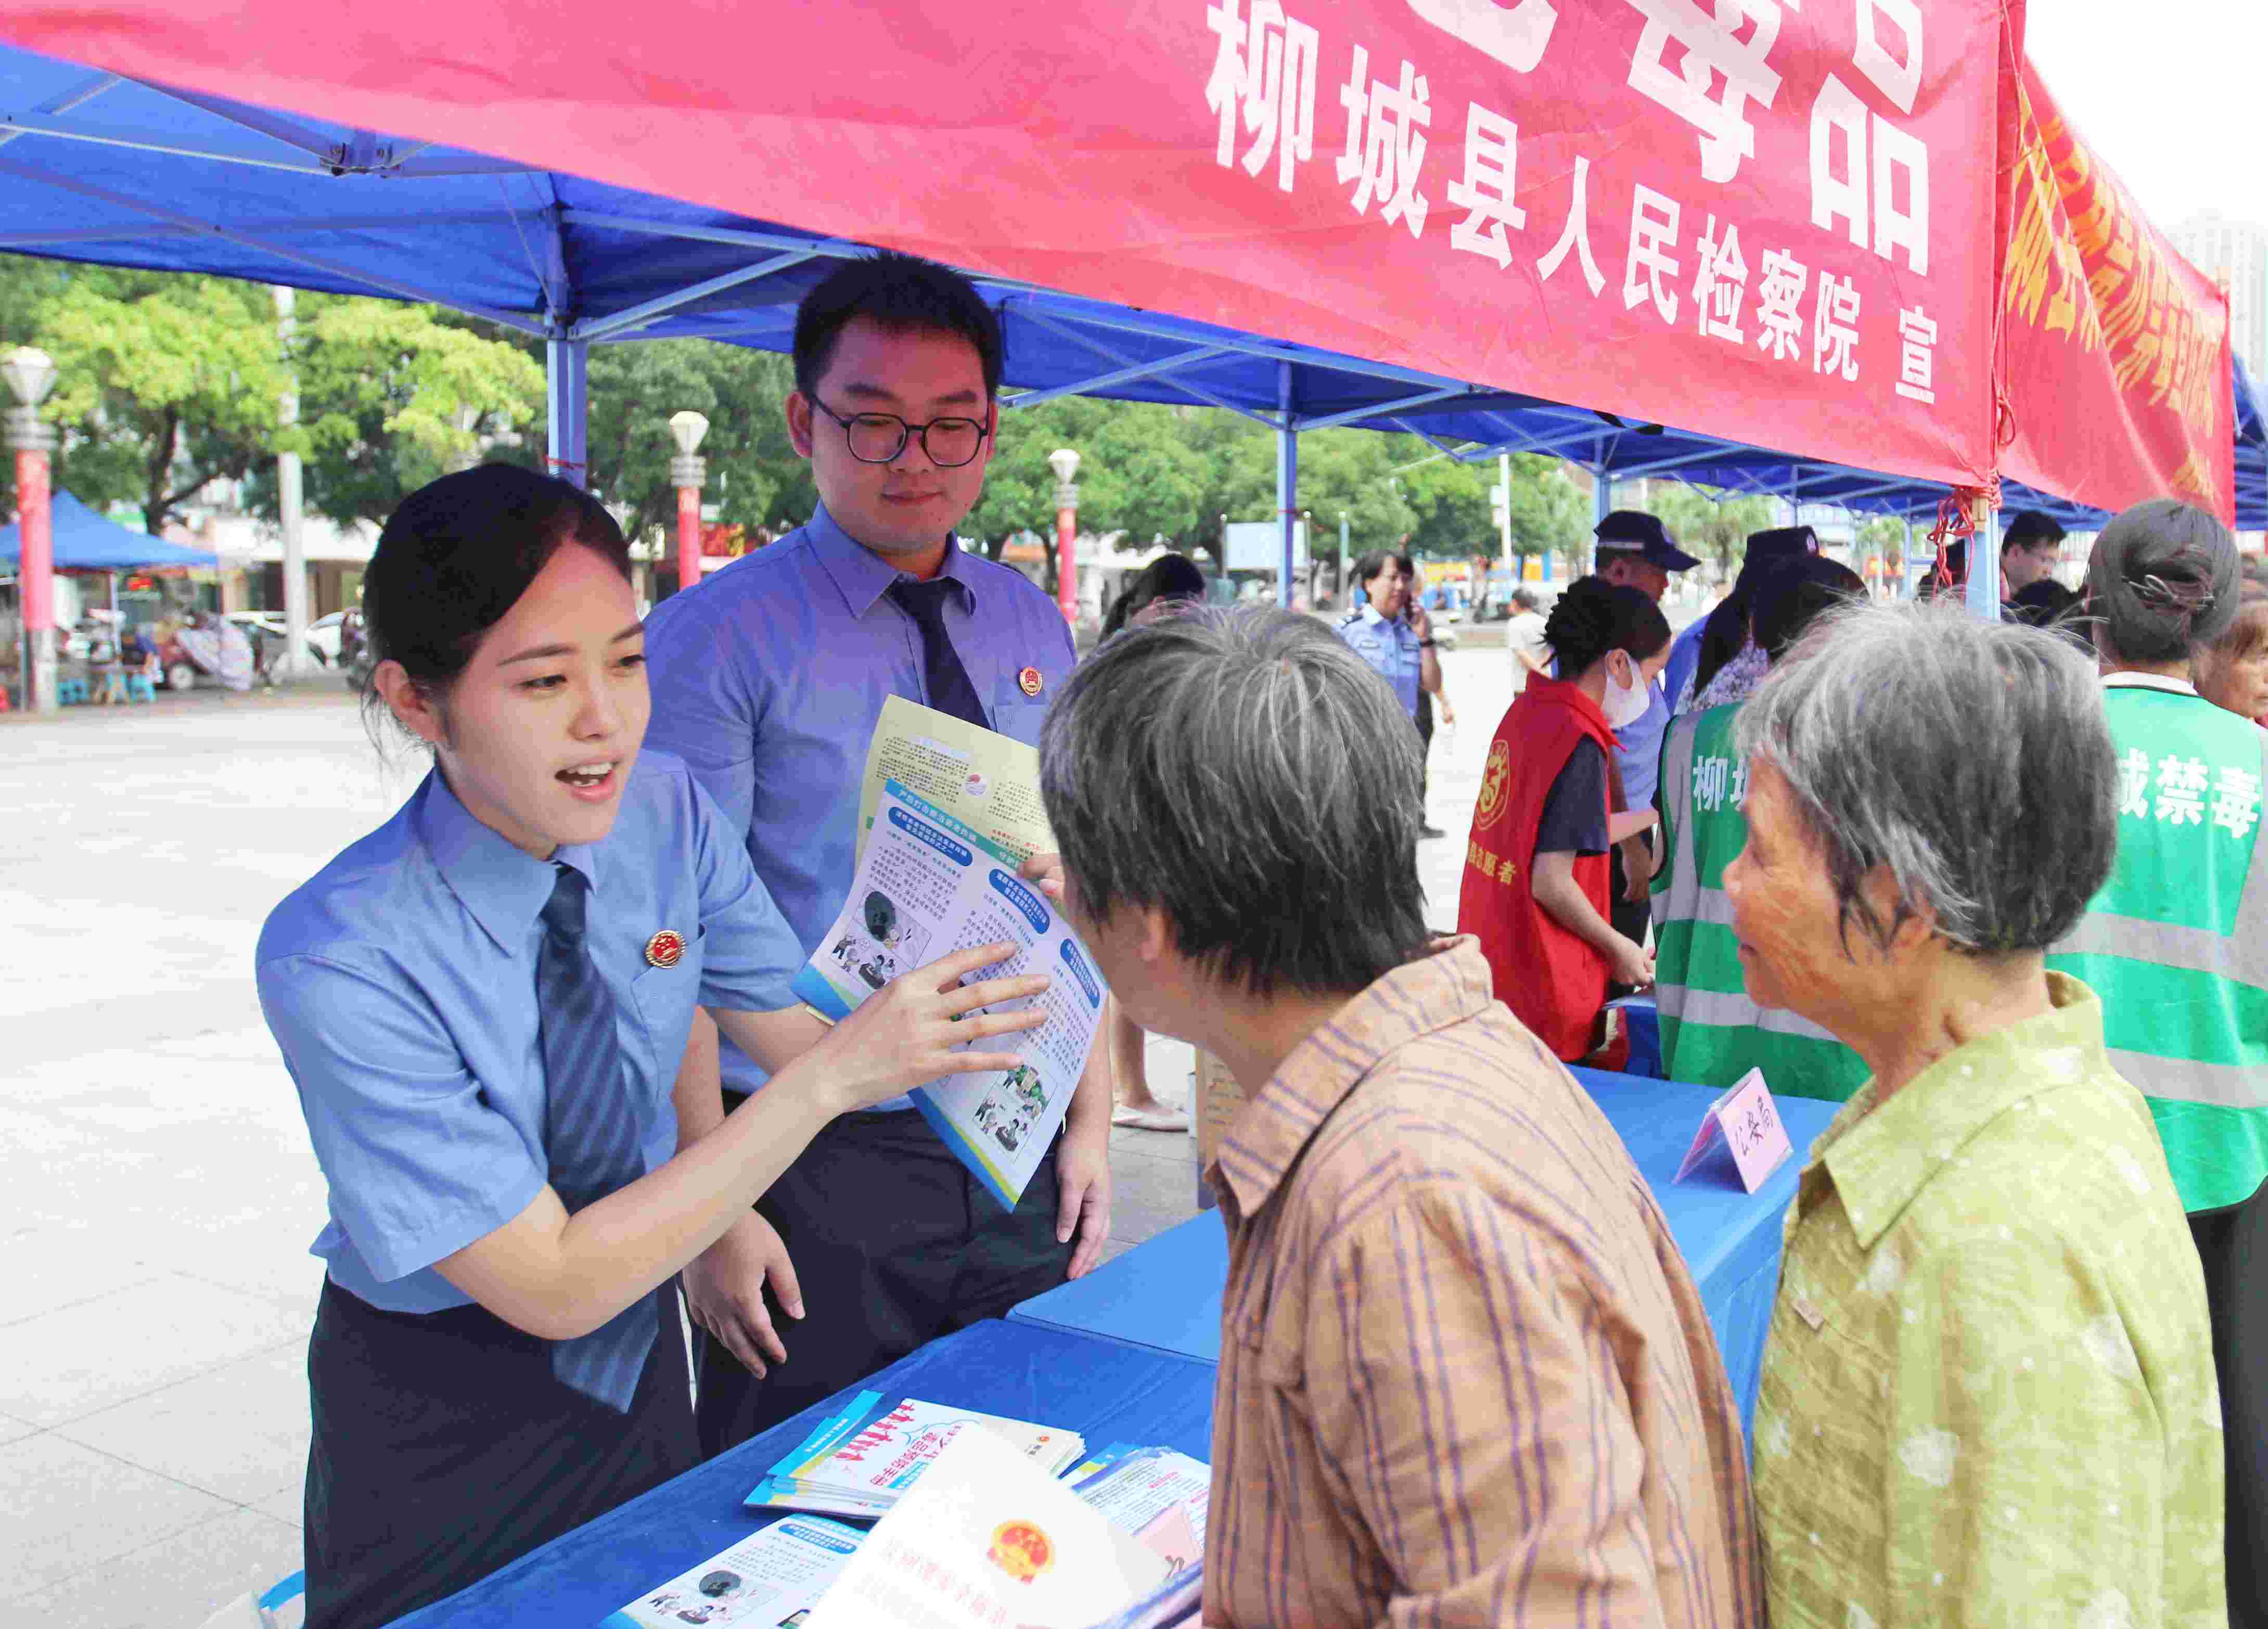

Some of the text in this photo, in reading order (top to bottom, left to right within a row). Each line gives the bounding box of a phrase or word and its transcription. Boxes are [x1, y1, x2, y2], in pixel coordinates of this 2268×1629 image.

[1205, 0, 1861, 382] 柳城县人民检察院
[1895, 306, 1937, 404] 宣
